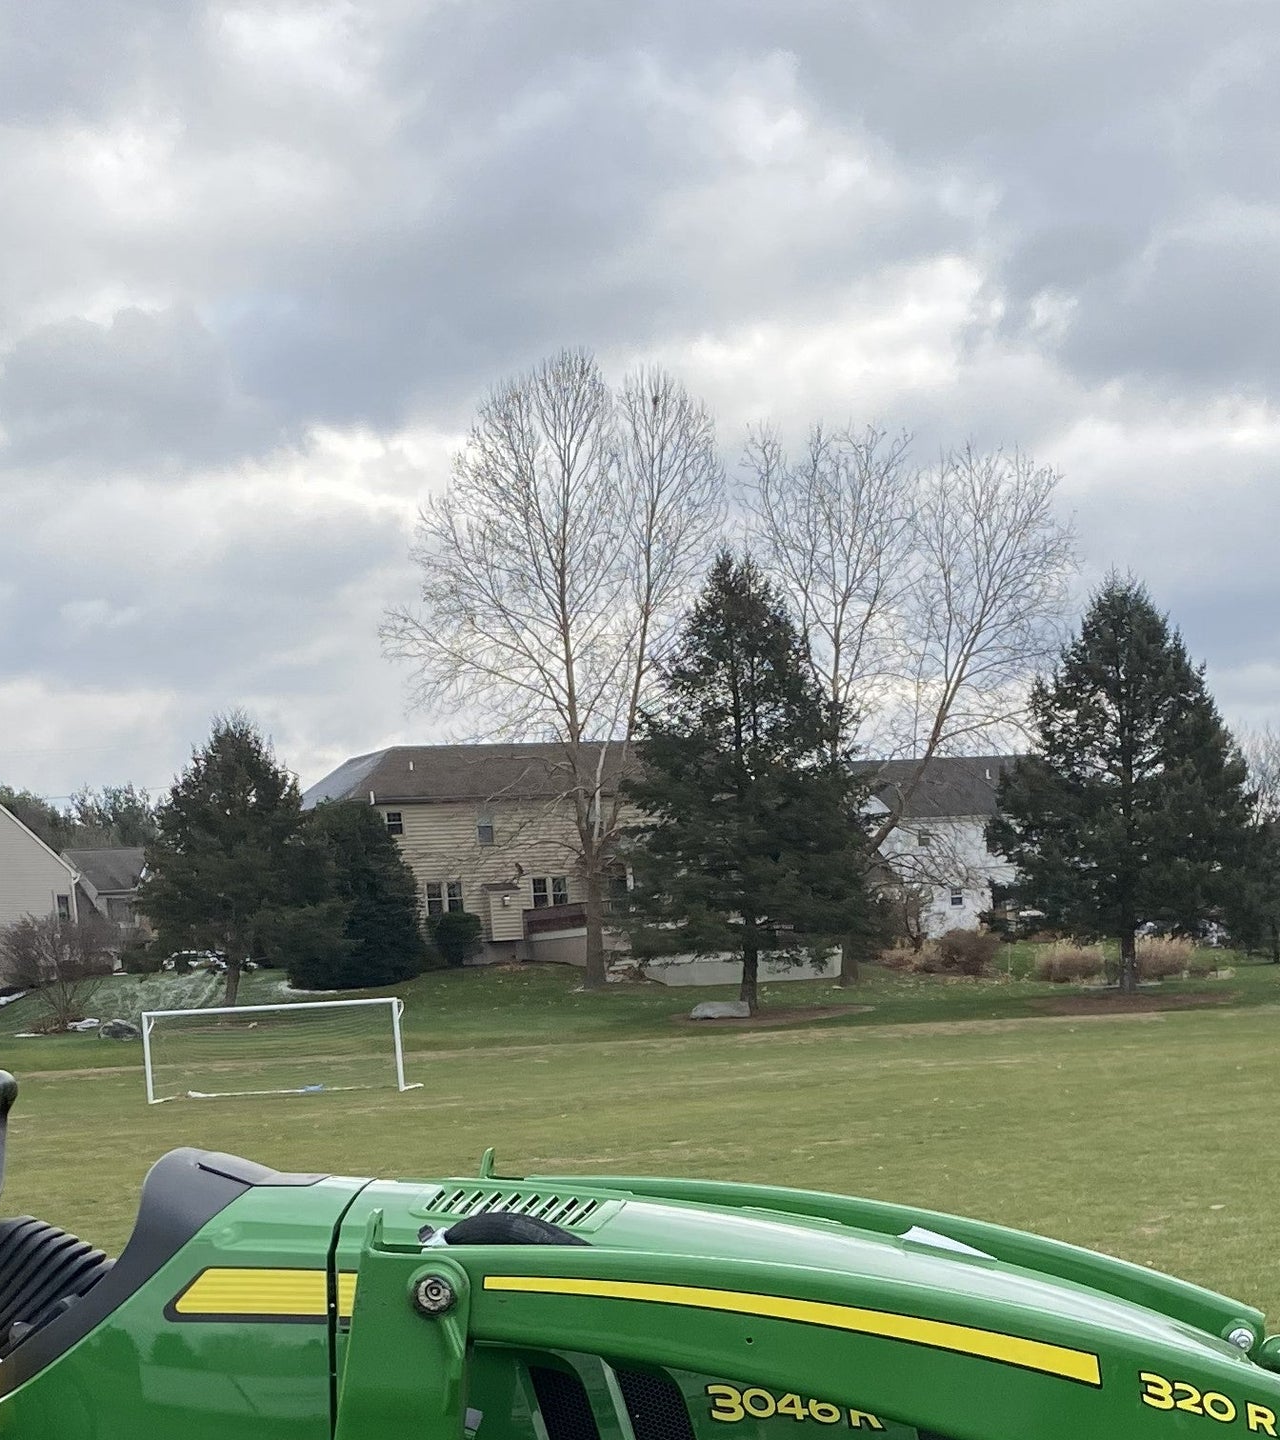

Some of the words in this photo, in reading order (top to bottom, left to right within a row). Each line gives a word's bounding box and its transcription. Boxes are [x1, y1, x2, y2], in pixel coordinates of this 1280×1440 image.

[706, 1384, 841, 1425] 3046
[1139, 1371, 1238, 1423] 320
[1245, 1401, 1280, 1438] R
